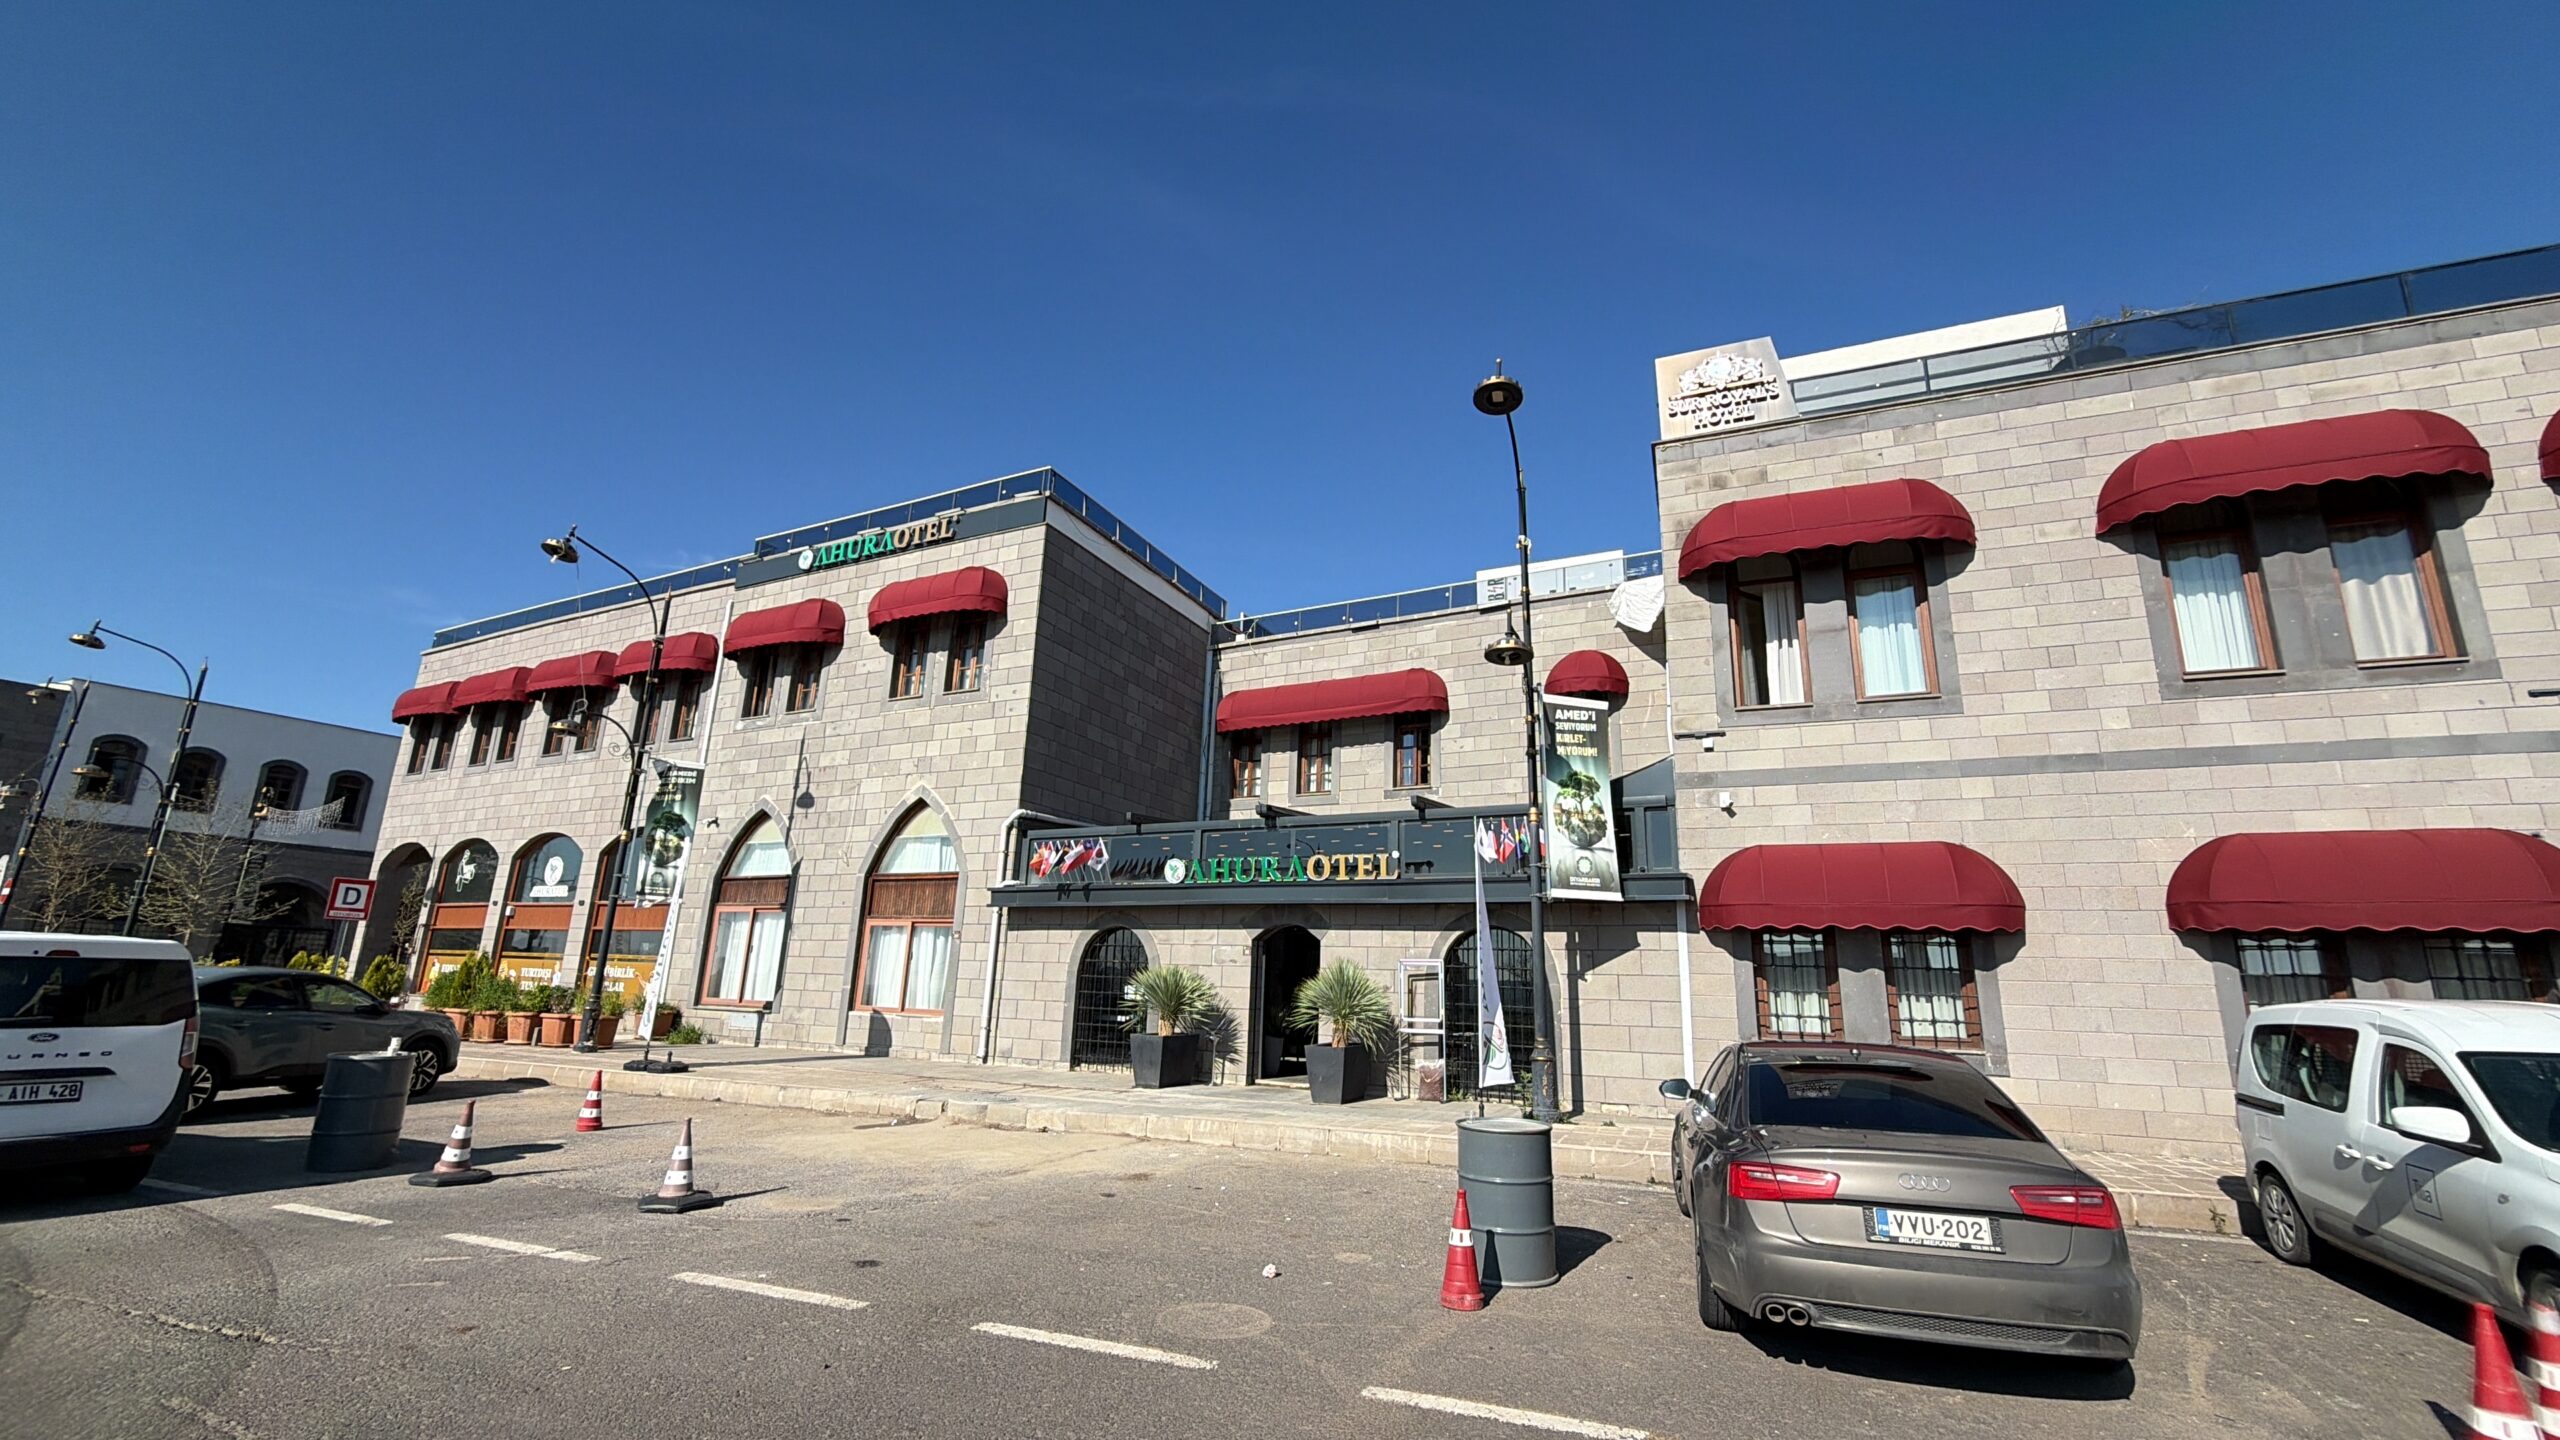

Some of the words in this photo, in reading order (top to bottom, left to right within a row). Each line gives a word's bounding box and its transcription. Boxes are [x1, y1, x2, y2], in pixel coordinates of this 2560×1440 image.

[1694, 406, 1755, 428] HOTEL
[342, 887, 361, 905] D
[8, 1086, 40, 1100] AIH
[49, 1085, 78, 1098] 428
